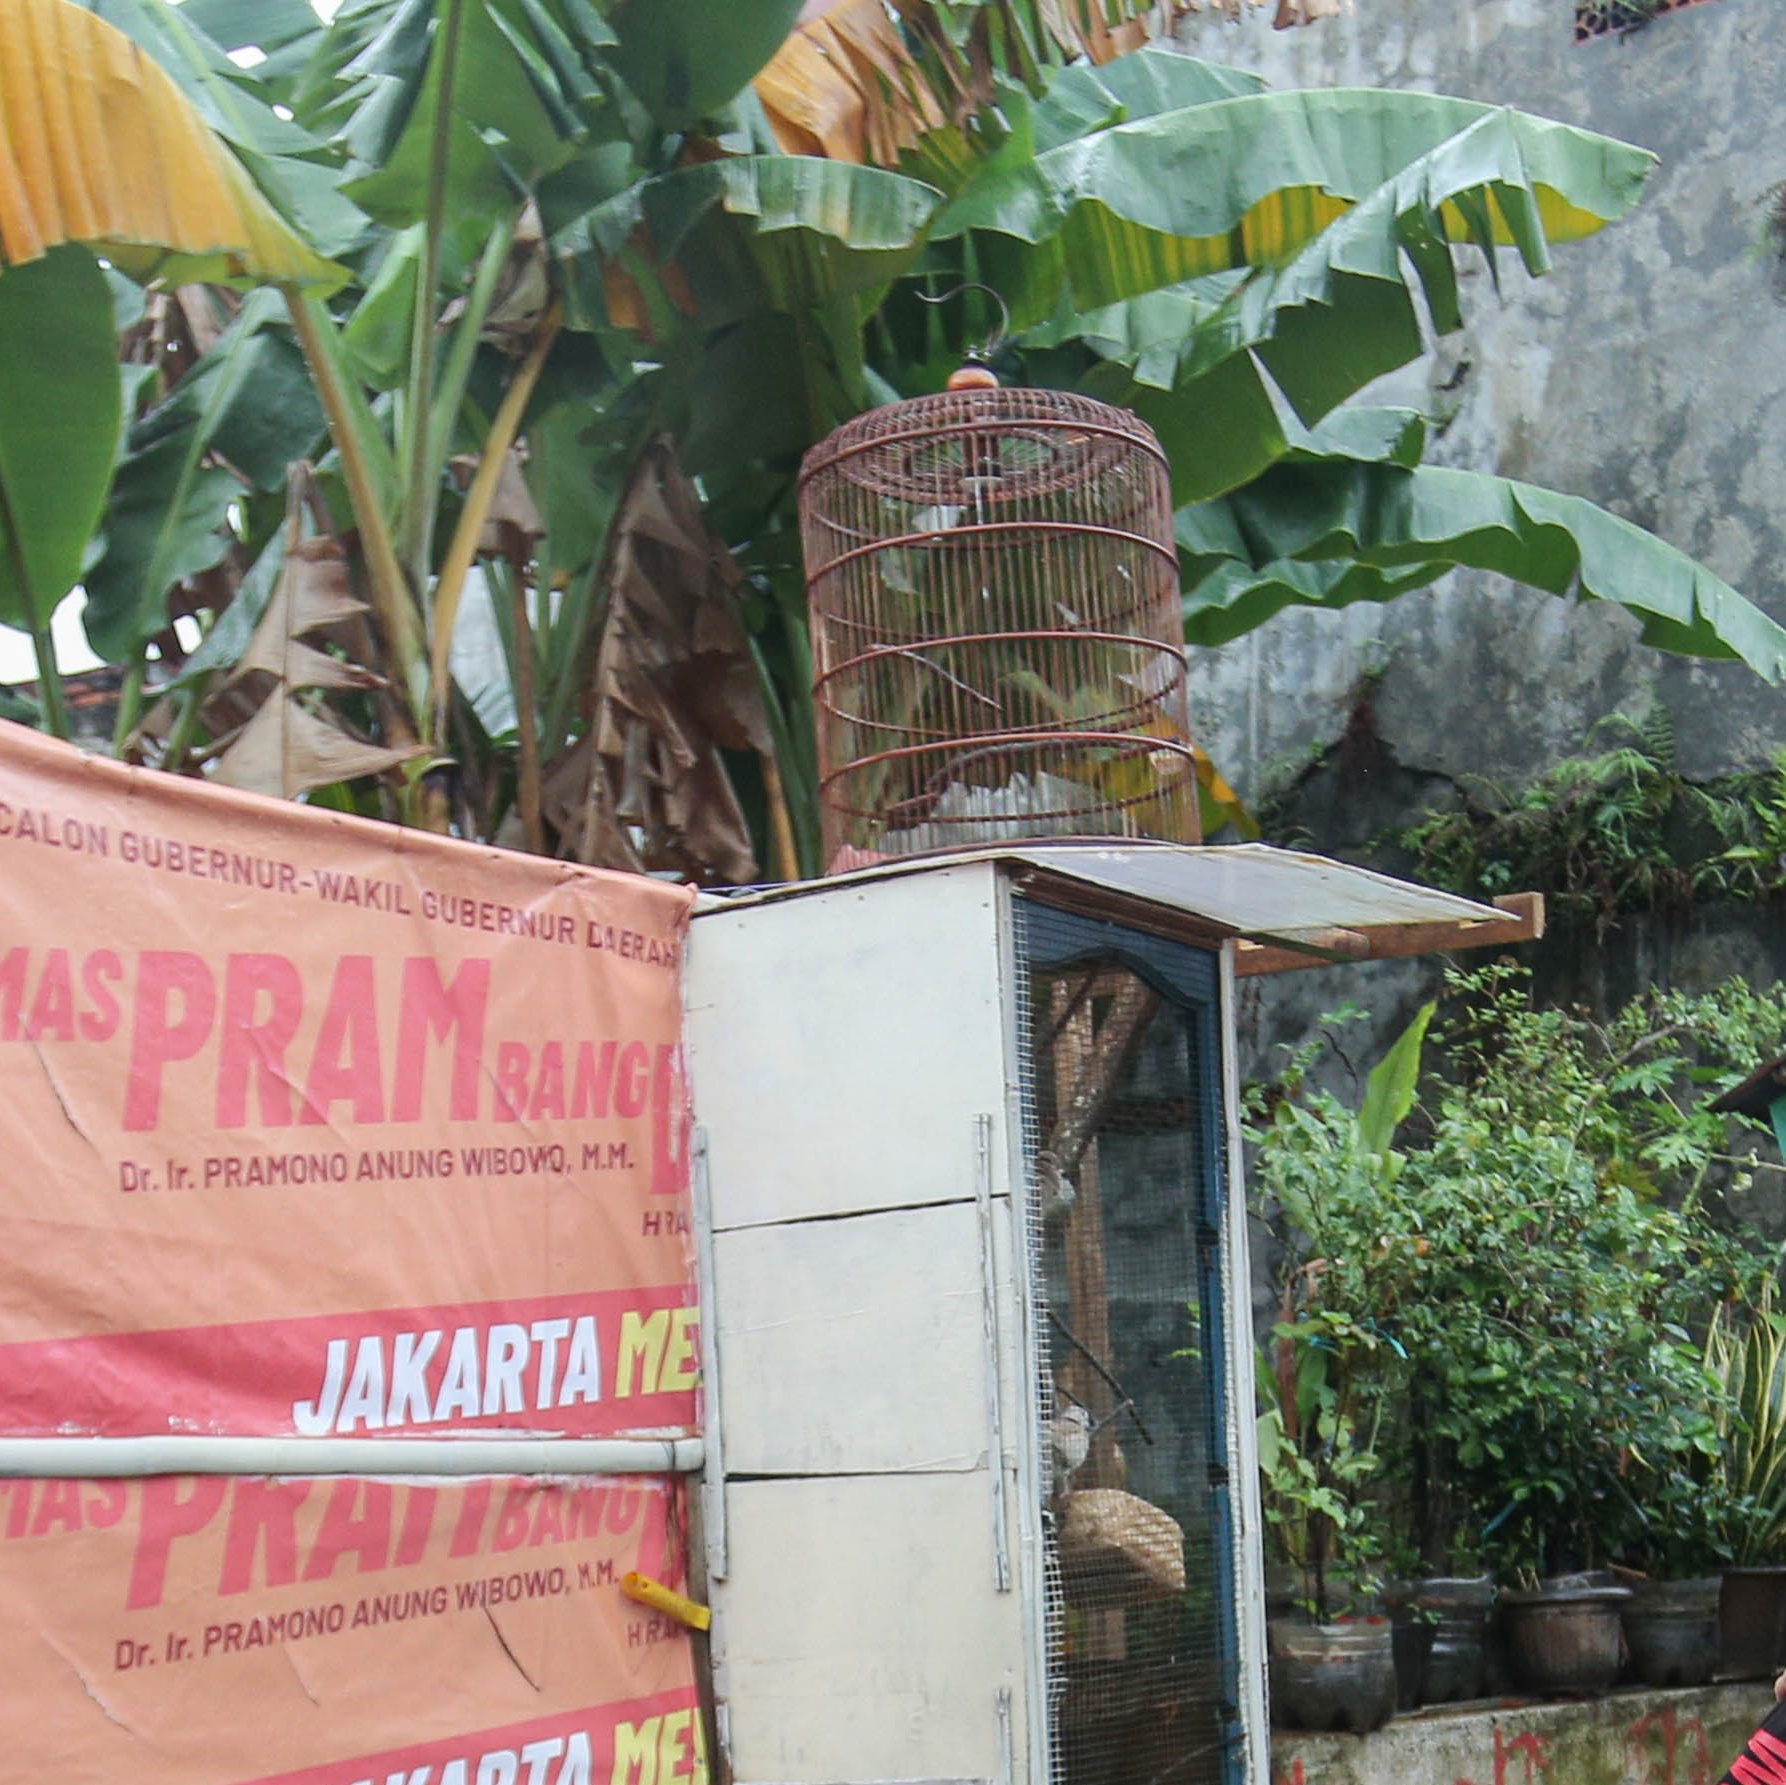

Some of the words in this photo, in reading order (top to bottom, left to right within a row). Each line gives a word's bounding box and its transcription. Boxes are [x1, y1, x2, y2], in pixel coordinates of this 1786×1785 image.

[119, 830, 411, 917] GUBERNUR-WAKIL
[421, 890, 576, 946] GUBERNUR
[121, 949, 492, 1133] PRAM
[493, 1040, 651, 1123] BANG
[118, 1160, 160, 1192] Dr.
[166, 1158, 196, 1191] Ir.
[203, 1152, 349, 1189] PRAMONO
[356, 1150, 455, 1182] ANUNG
[460, 1143, 572, 1178] WIBOWO,
[581, 1142, 635, 1171] M.M.
[291, 1315, 602, 1436] JAKARTA
[114, 1638, 156, 1672] Dr.
[165, 1631, 193, 1664] Ir.
[202, 1603, 347, 1657] PRAMONO
[353, 1585, 447, 1629] ANUNG
[454, 1566, 571, 1611] WIBOWO,
[576, 1558, 621, 1593] M.M.
